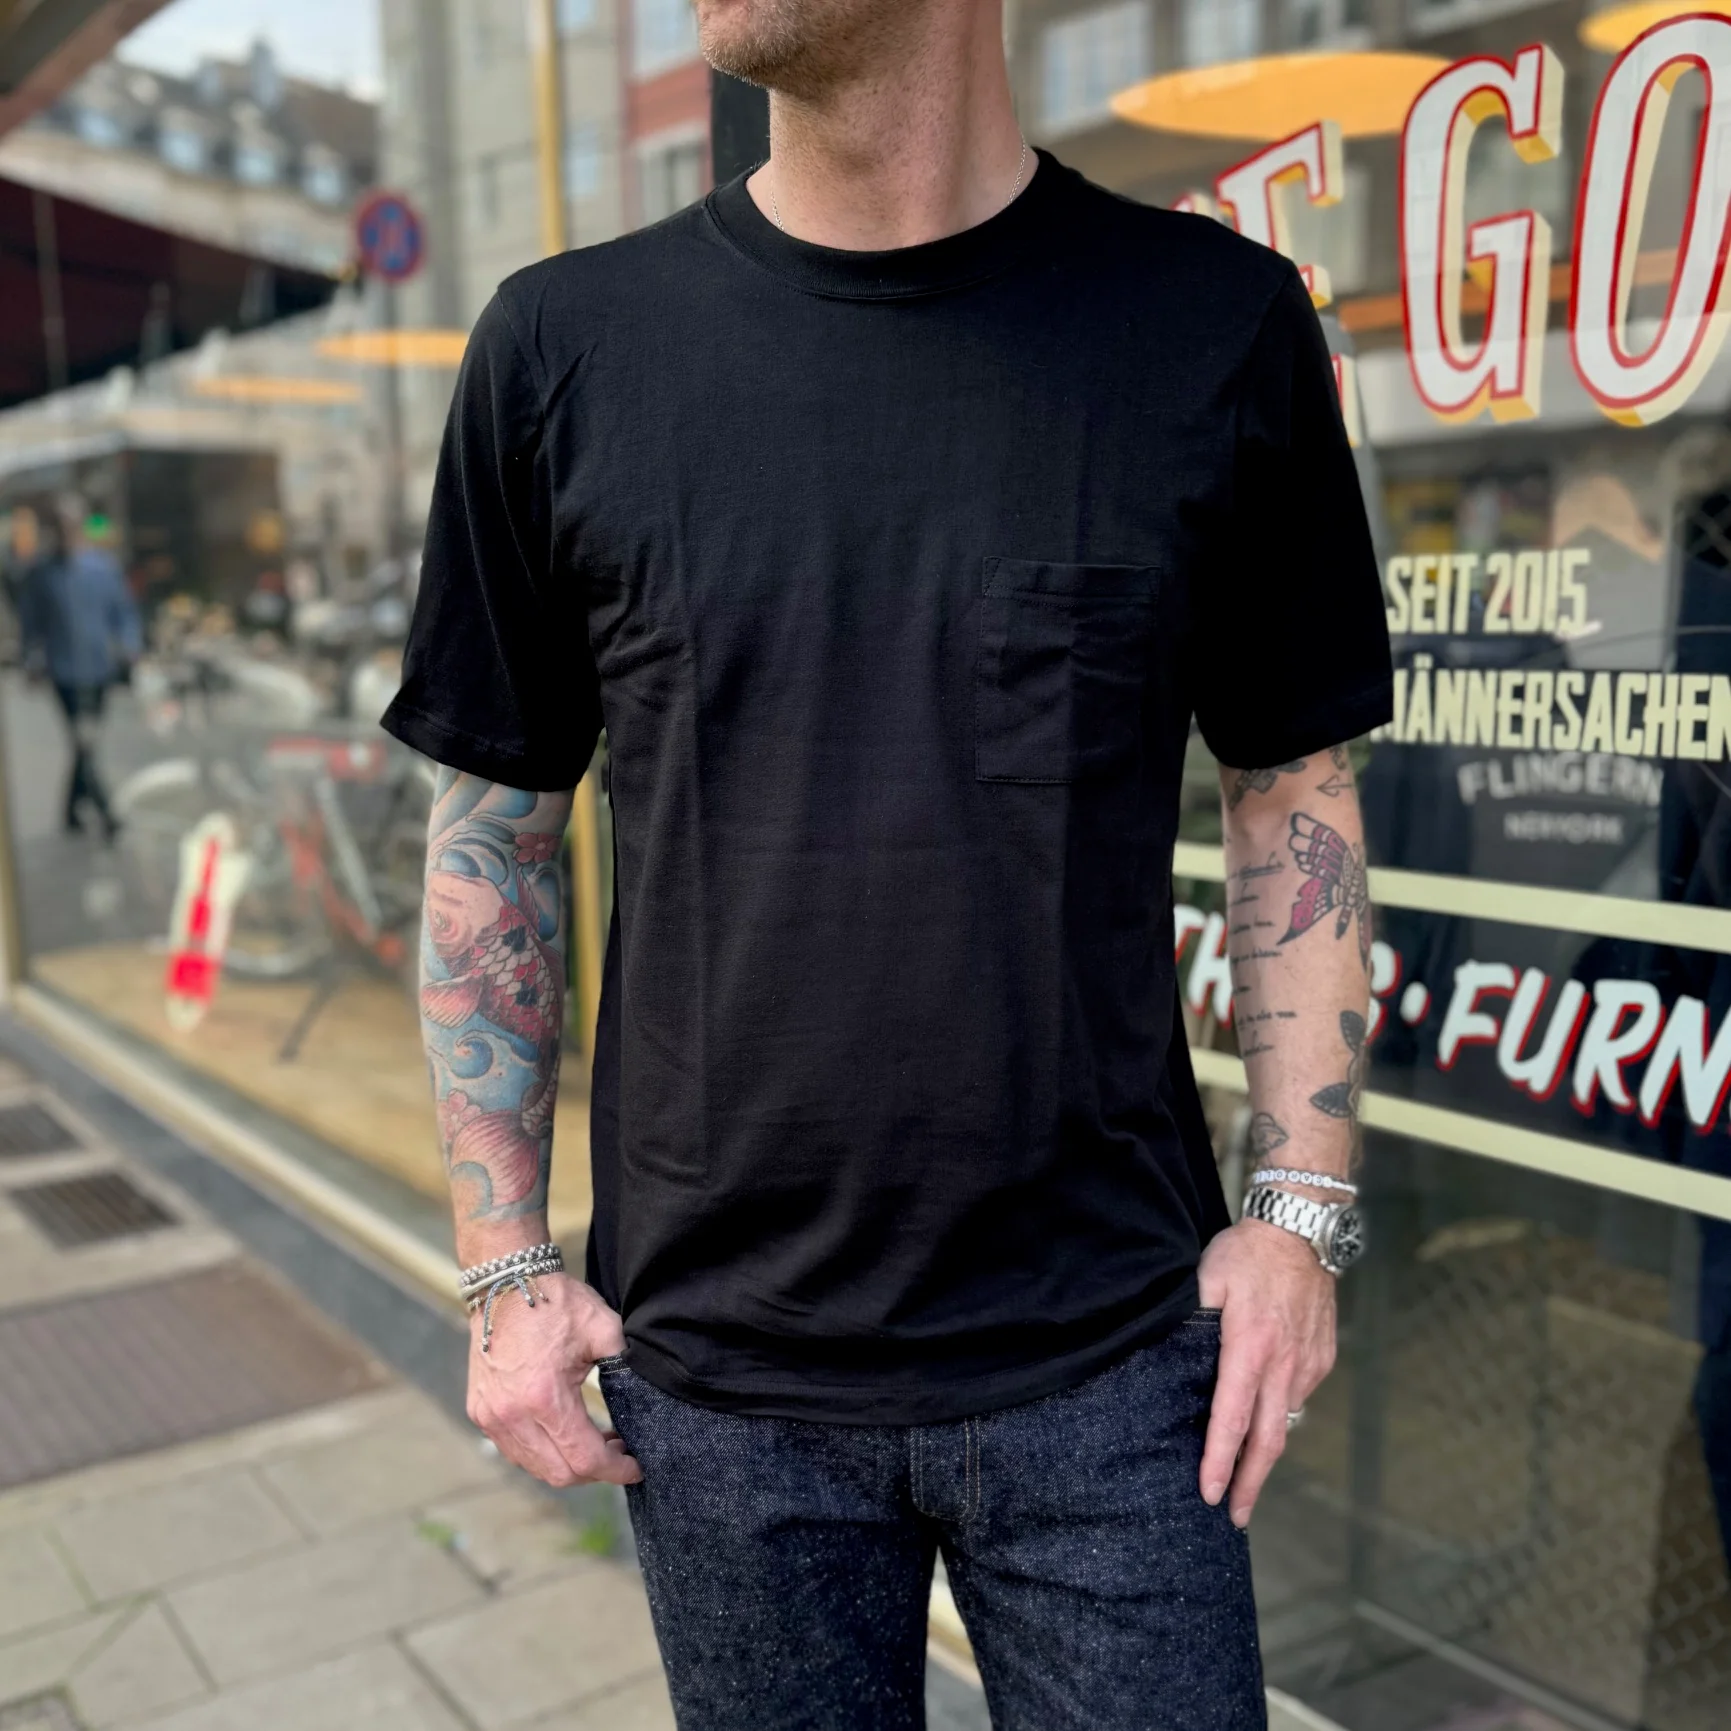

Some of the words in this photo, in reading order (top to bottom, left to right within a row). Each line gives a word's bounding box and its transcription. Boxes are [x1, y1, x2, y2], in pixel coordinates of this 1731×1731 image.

[1400, 12, 1731, 427] GO
[1385, 553, 1478, 634] SEIT
[1483, 548, 1592, 635] 2015
[1457, 752, 1664, 806] FLINGERN
[1436, 959, 1731, 1137] FURN
